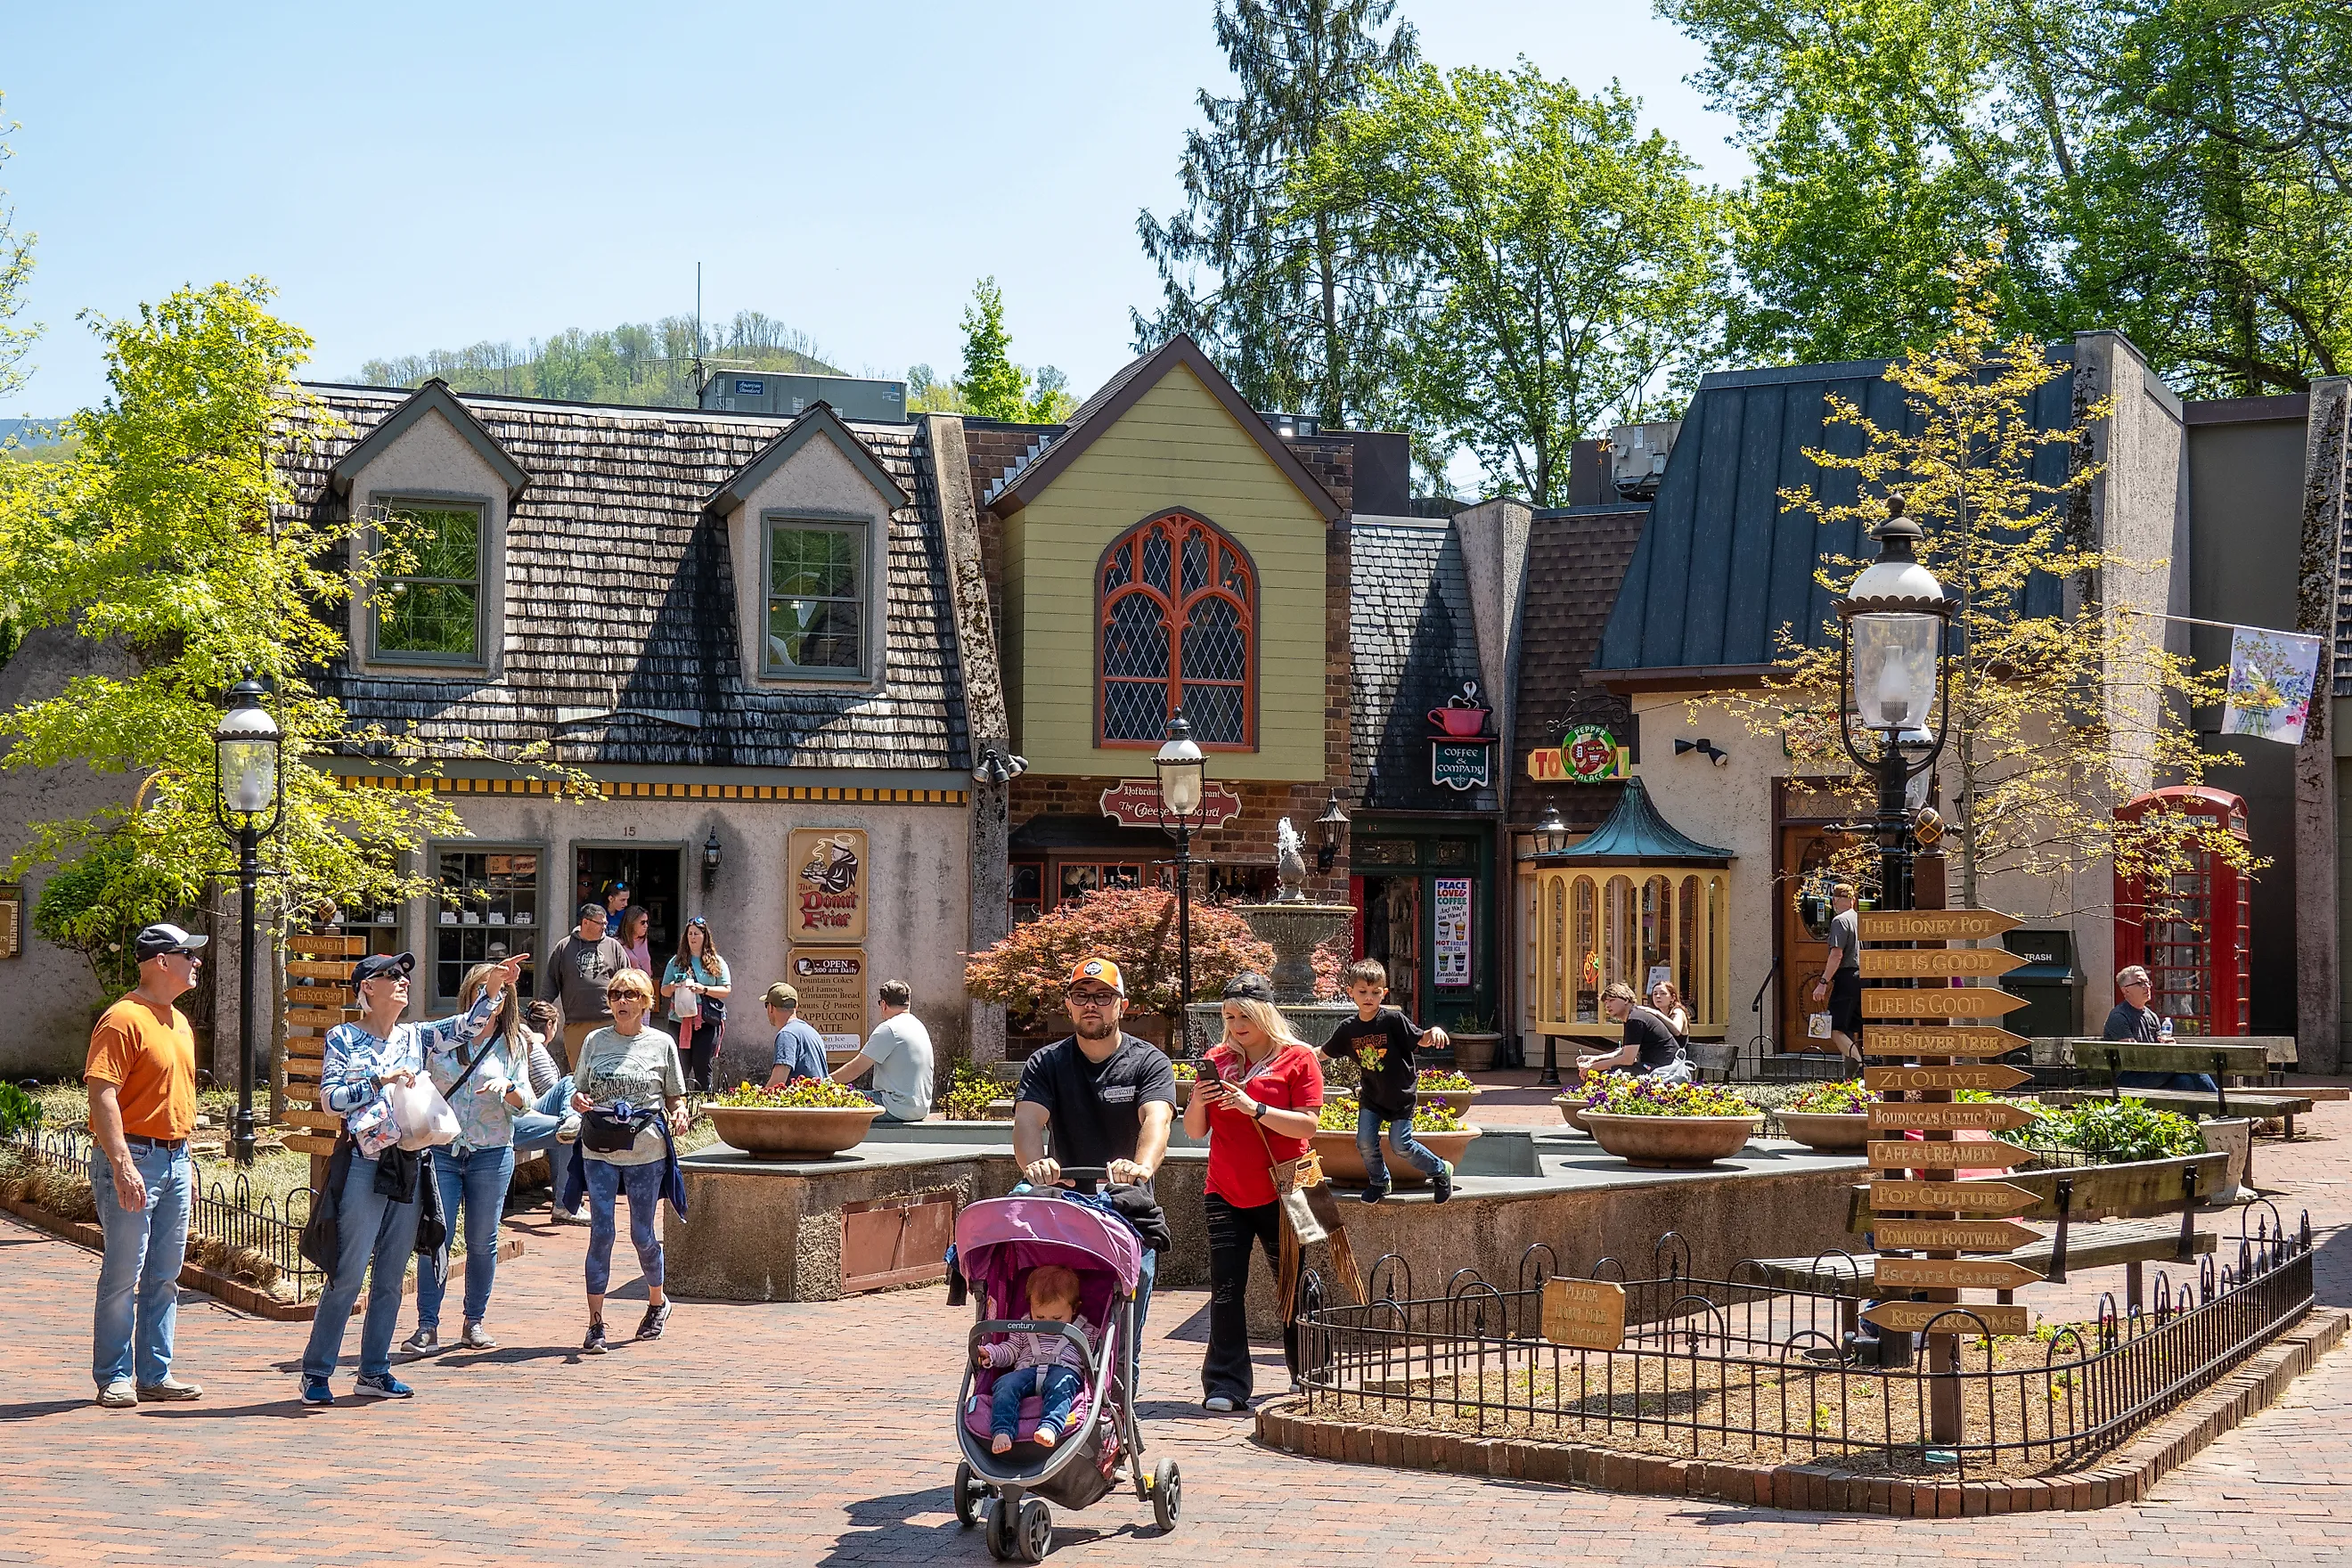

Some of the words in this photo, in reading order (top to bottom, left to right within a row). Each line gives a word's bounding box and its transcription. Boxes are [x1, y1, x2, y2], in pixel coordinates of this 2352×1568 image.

[1574, 726, 1605, 737] PEPPER
[1444, 747, 1479, 757] COFFEE
[1436, 764, 1484, 775] COMPANY
[1572, 772, 1605, 781] PALACE
[1119, 801, 1134, 812] The
[1134, 803, 1170, 818] Cheese
[624, 827, 636, 837] 15
[798, 883, 813, 891] The
[799, 891, 860, 909] Donut
[1437, 897, 1467, 905] COFFEE
[799, 909, 852, 929] Friar
[1862, 918, 1894, 934] THE
[1898, 917, 1956, 934] HONEY
[1959, 916, 1992, 933] POT
[306, 939, 332, 951] NAME
[334, 941, 344, 951] IT
[1865, 955, 1906, 971] LIFE
[1912, 955, 1929, 970] IS
[1932, 954, 1993, 971] GOOD
[2023, 953, 2052, 961] TRASH
[840, 967, 858, 975] Daily
[295, 989, 306, 1000] THE
[307, 990, 324, 1001] SOCK
[324, 991, 342, 1002] SHOP
[822, 1000, 830, 1009] &
[1867, 994, 1906, 1014] LIFE
[1909, 994, 1924, 1014] IS
[1928, 994, 1985, 1014] GOOD
[796, 1011, 860, 1020] CAPPUCCINO
[1868, 1033, 1899, 1049] THE
[1903, 1033, 1956, 1049] SILVER
[1959, 1033, 1999, 1049] TREE
[1879, 1072, 1902, 1087] ZI
[1910, 1072, 1988, 1087] OLIVE
[1875, 1108, 1940, 1124] BOUDICCA'S
[1942, 1109, 1982, 1125] CELTIC
[1984, 1109, 2006, 1125] PUB
[1874, 1144, 1909, 1162] CAFE
[1912, 1147, 1922, 1160] &
[1924, 1144, 1998, 1162] CREAMERY
[1877, 1187, 1915, 1204] POP
[1918, 1187, 2009, 1207] CULTURE
[1879, 1228, 1939, 1245] COMFORT
[1942, 1229, 2010, 1246] FOOTWEAR
[1880, 1264, 1944, 1283] ESCAPE
[1948, 1267, 2012, 1285] GAMES
[1565, 1284, 1598, 1303] PLEASE
[1585, 1307, 1607, 1325] FEED
[1891, 1309, 2023, 1330] RESTROOMS
[1007, 1322, 1036, 1331] century
[1572, 1324, 1611, 1345] PIGEONS
